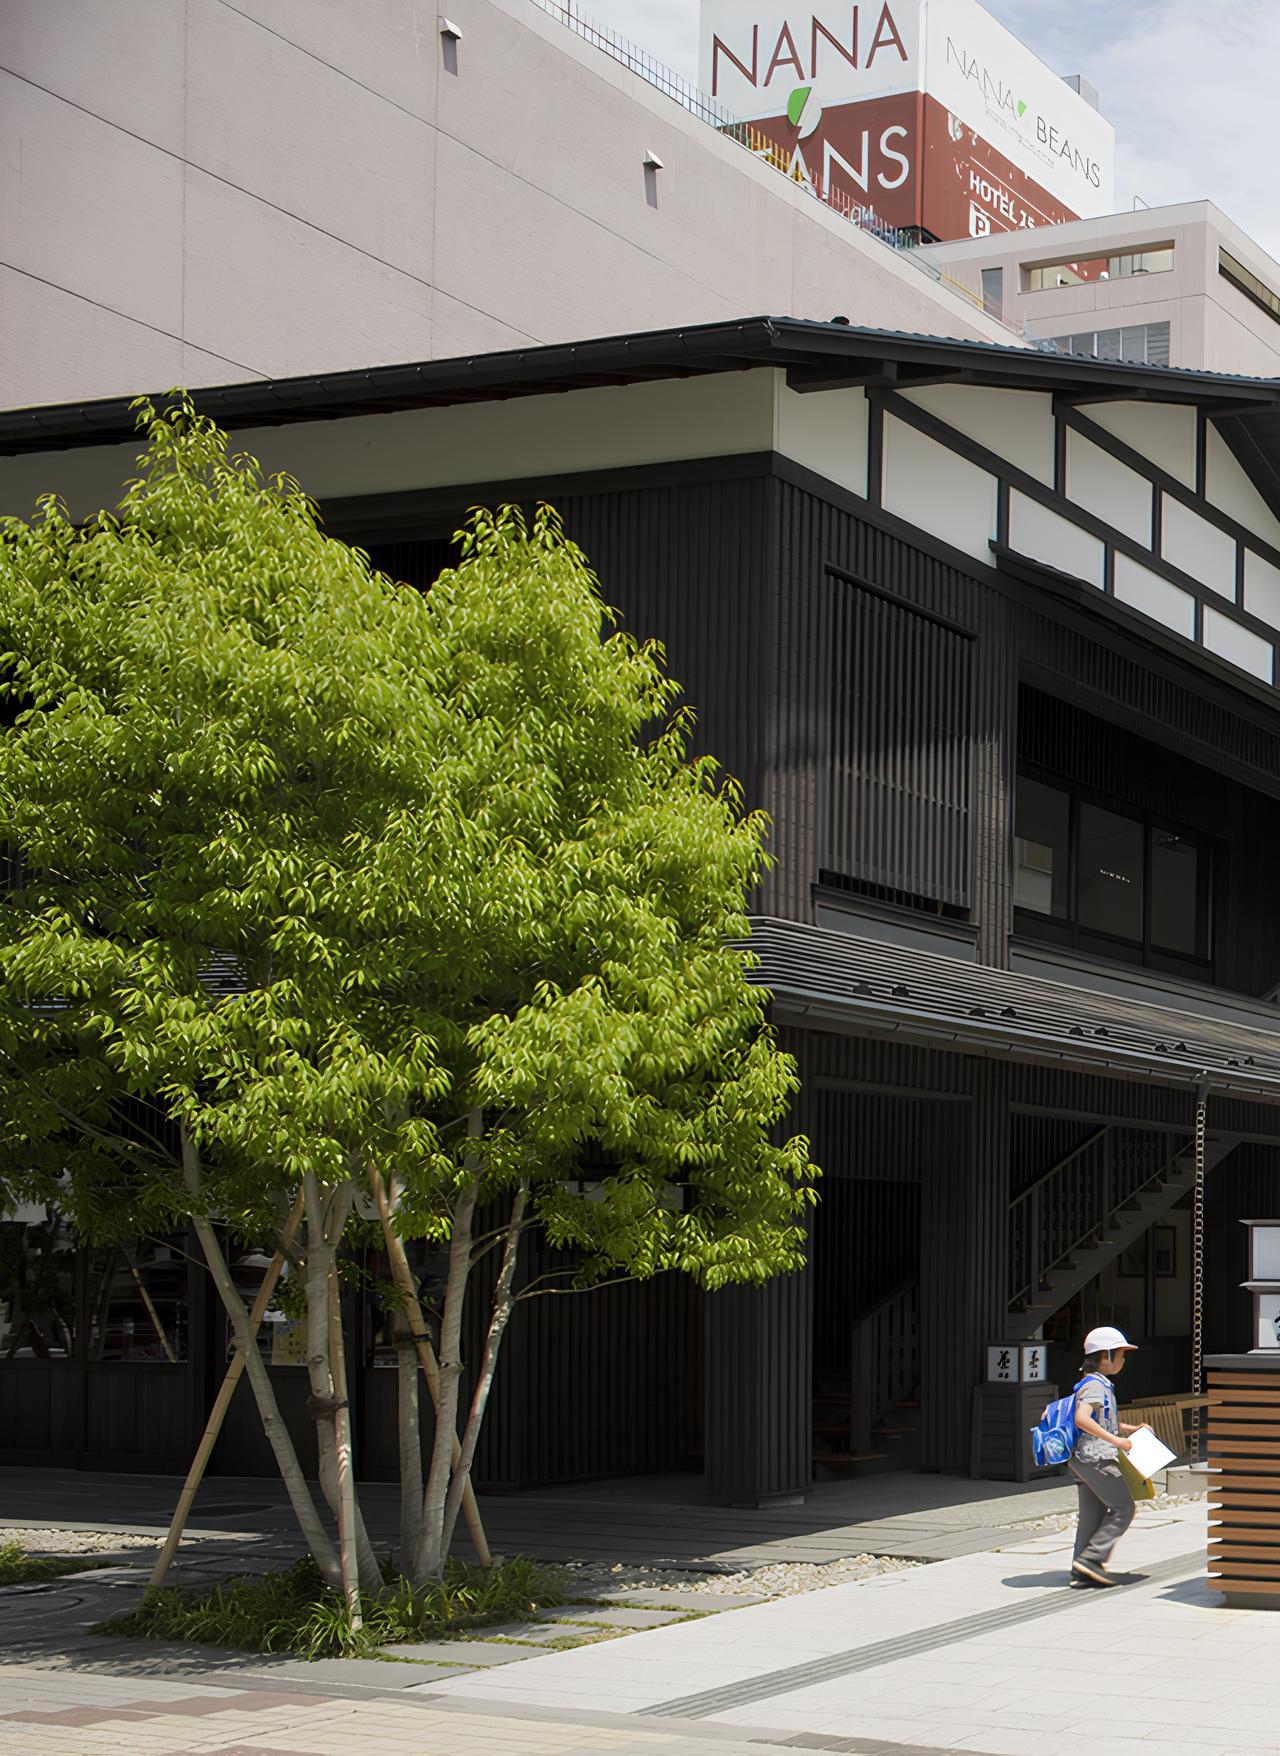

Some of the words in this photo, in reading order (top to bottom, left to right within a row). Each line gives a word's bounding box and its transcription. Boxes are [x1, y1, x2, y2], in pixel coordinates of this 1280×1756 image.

[711, 0, 909, 97] NANA
[946, 36, 1017, 122] NANA
[1036, 115, 1101, 188] BEANS
[969, 170, 1018, 225] HOTEL
